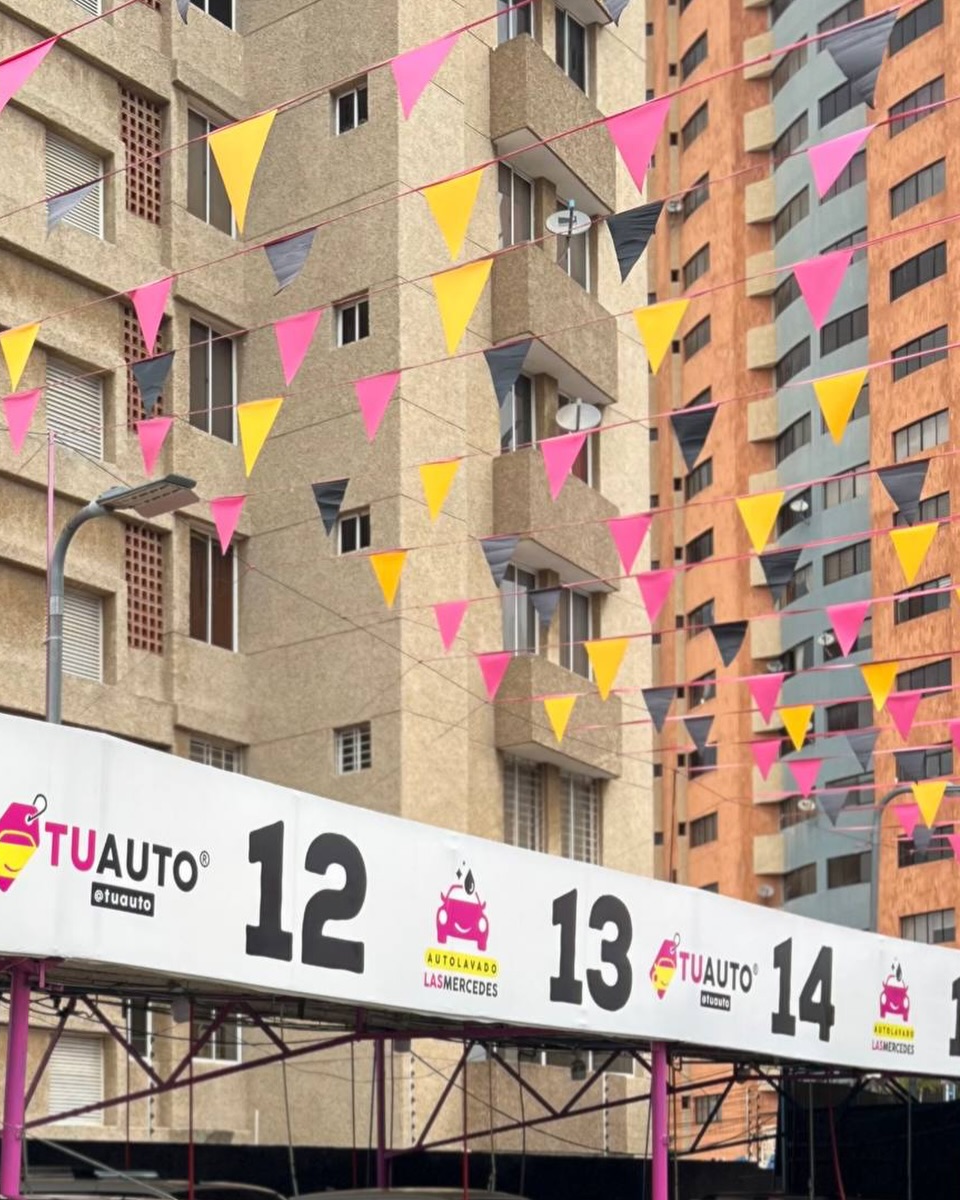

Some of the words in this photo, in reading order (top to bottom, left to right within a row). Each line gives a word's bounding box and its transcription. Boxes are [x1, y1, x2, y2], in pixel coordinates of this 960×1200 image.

[94, 885, 151, 911] @tuauto
[245, 820, 368, 974] 12
[427, 952, 497, 975] AUTOLAVADO
[549, 888, 633, 1012] 13
[423, 971, 499, 998] LASMERCEDES
[771, 937, 835, 1042] 14
